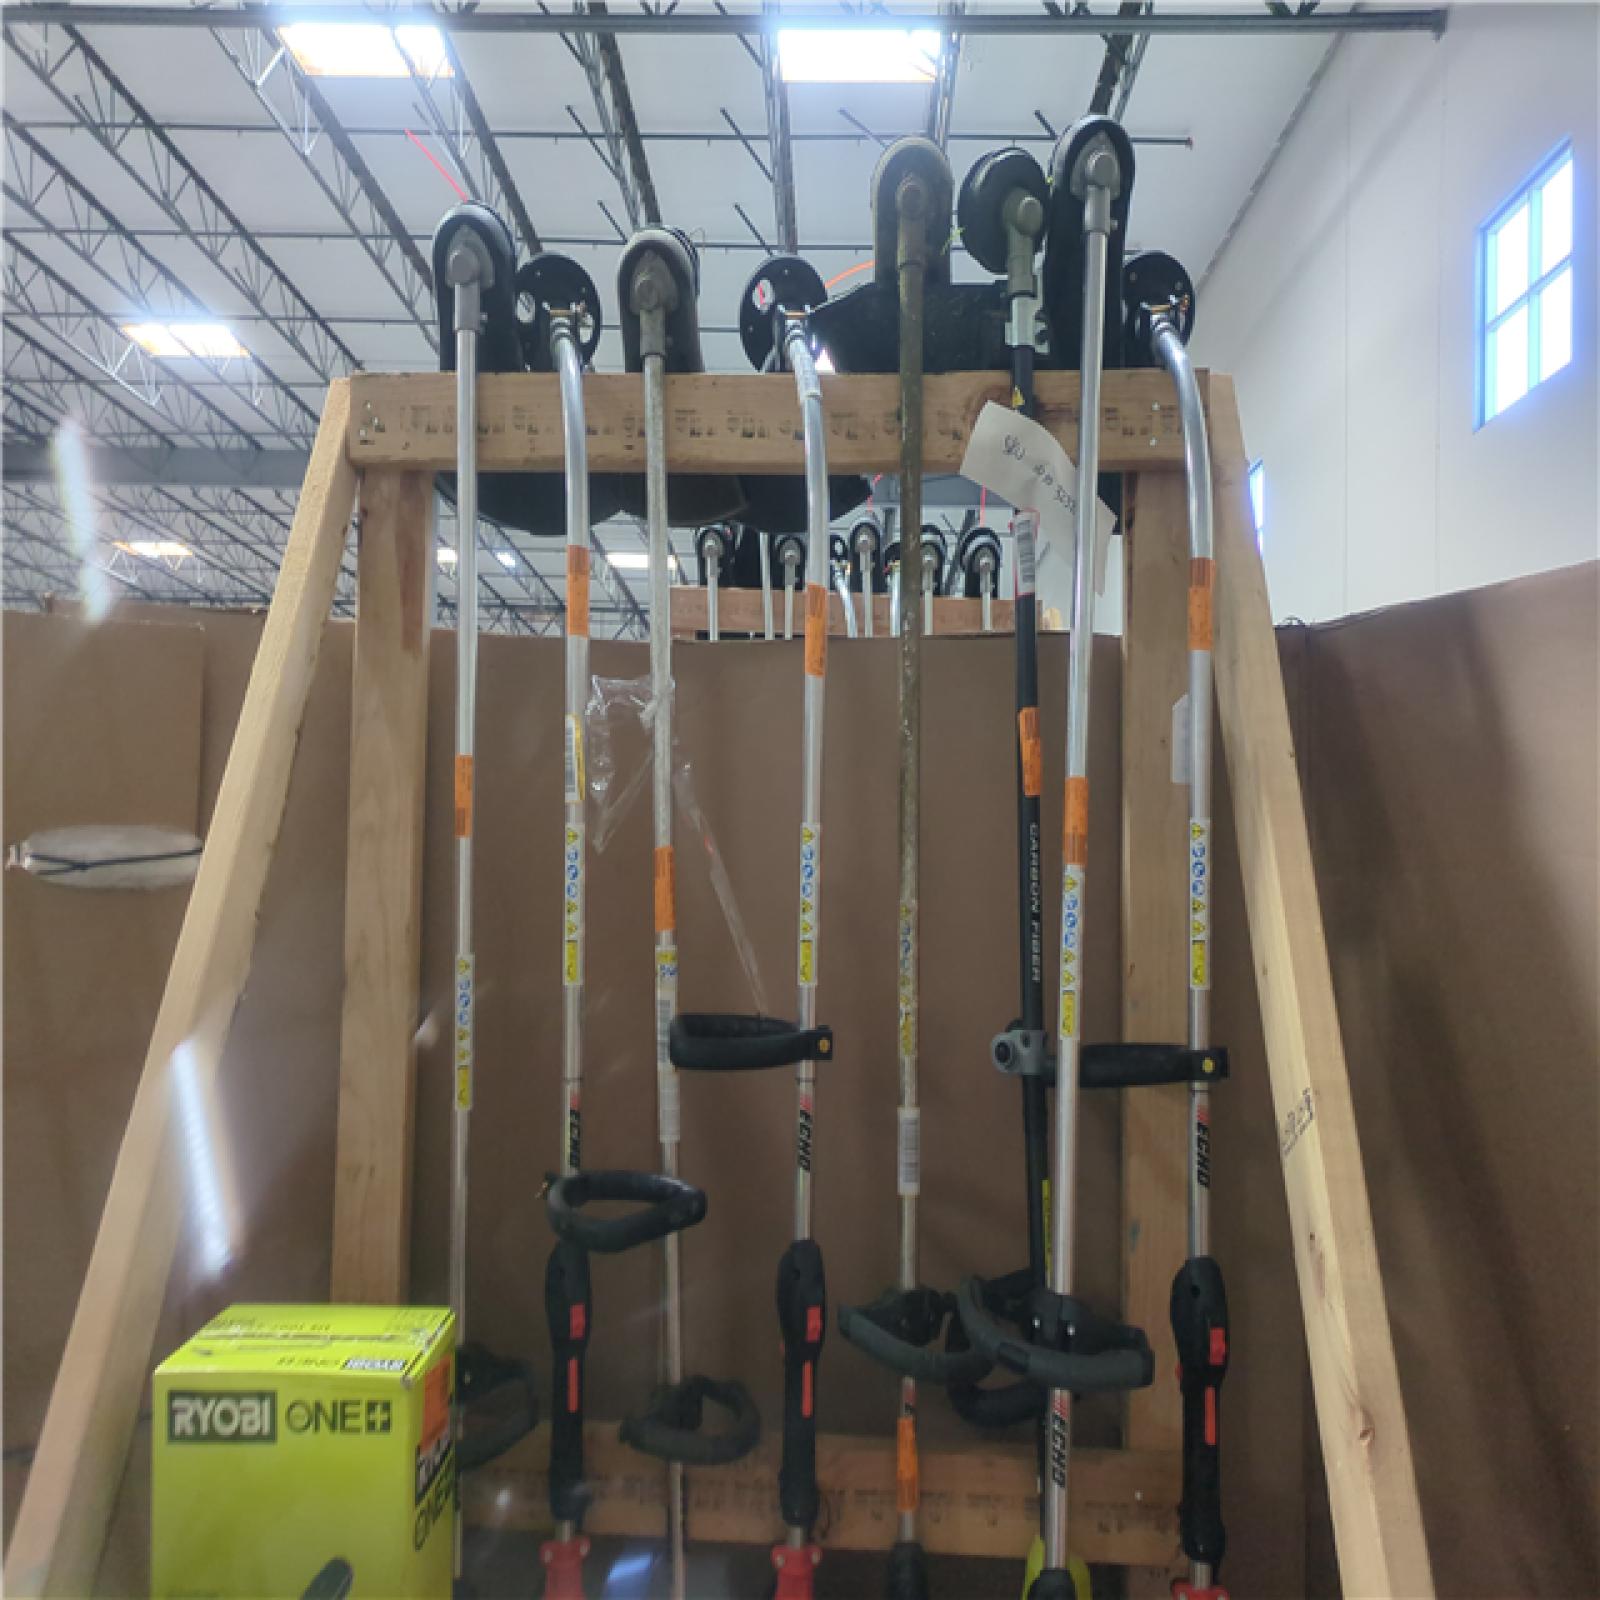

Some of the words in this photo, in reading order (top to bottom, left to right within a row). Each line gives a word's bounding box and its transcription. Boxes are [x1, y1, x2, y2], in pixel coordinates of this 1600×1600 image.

[1029, 822, 1041, 913] CARBON
[1031, 920, 1042, 983] FIBER
[799, 1110, 812, 1172] ECHO
[1197, 1122, 1211, 1187] ECHO
[171, 1397, 272, 1436] RYOBI
[1052, 1413, 1066, 1488] ECHO
